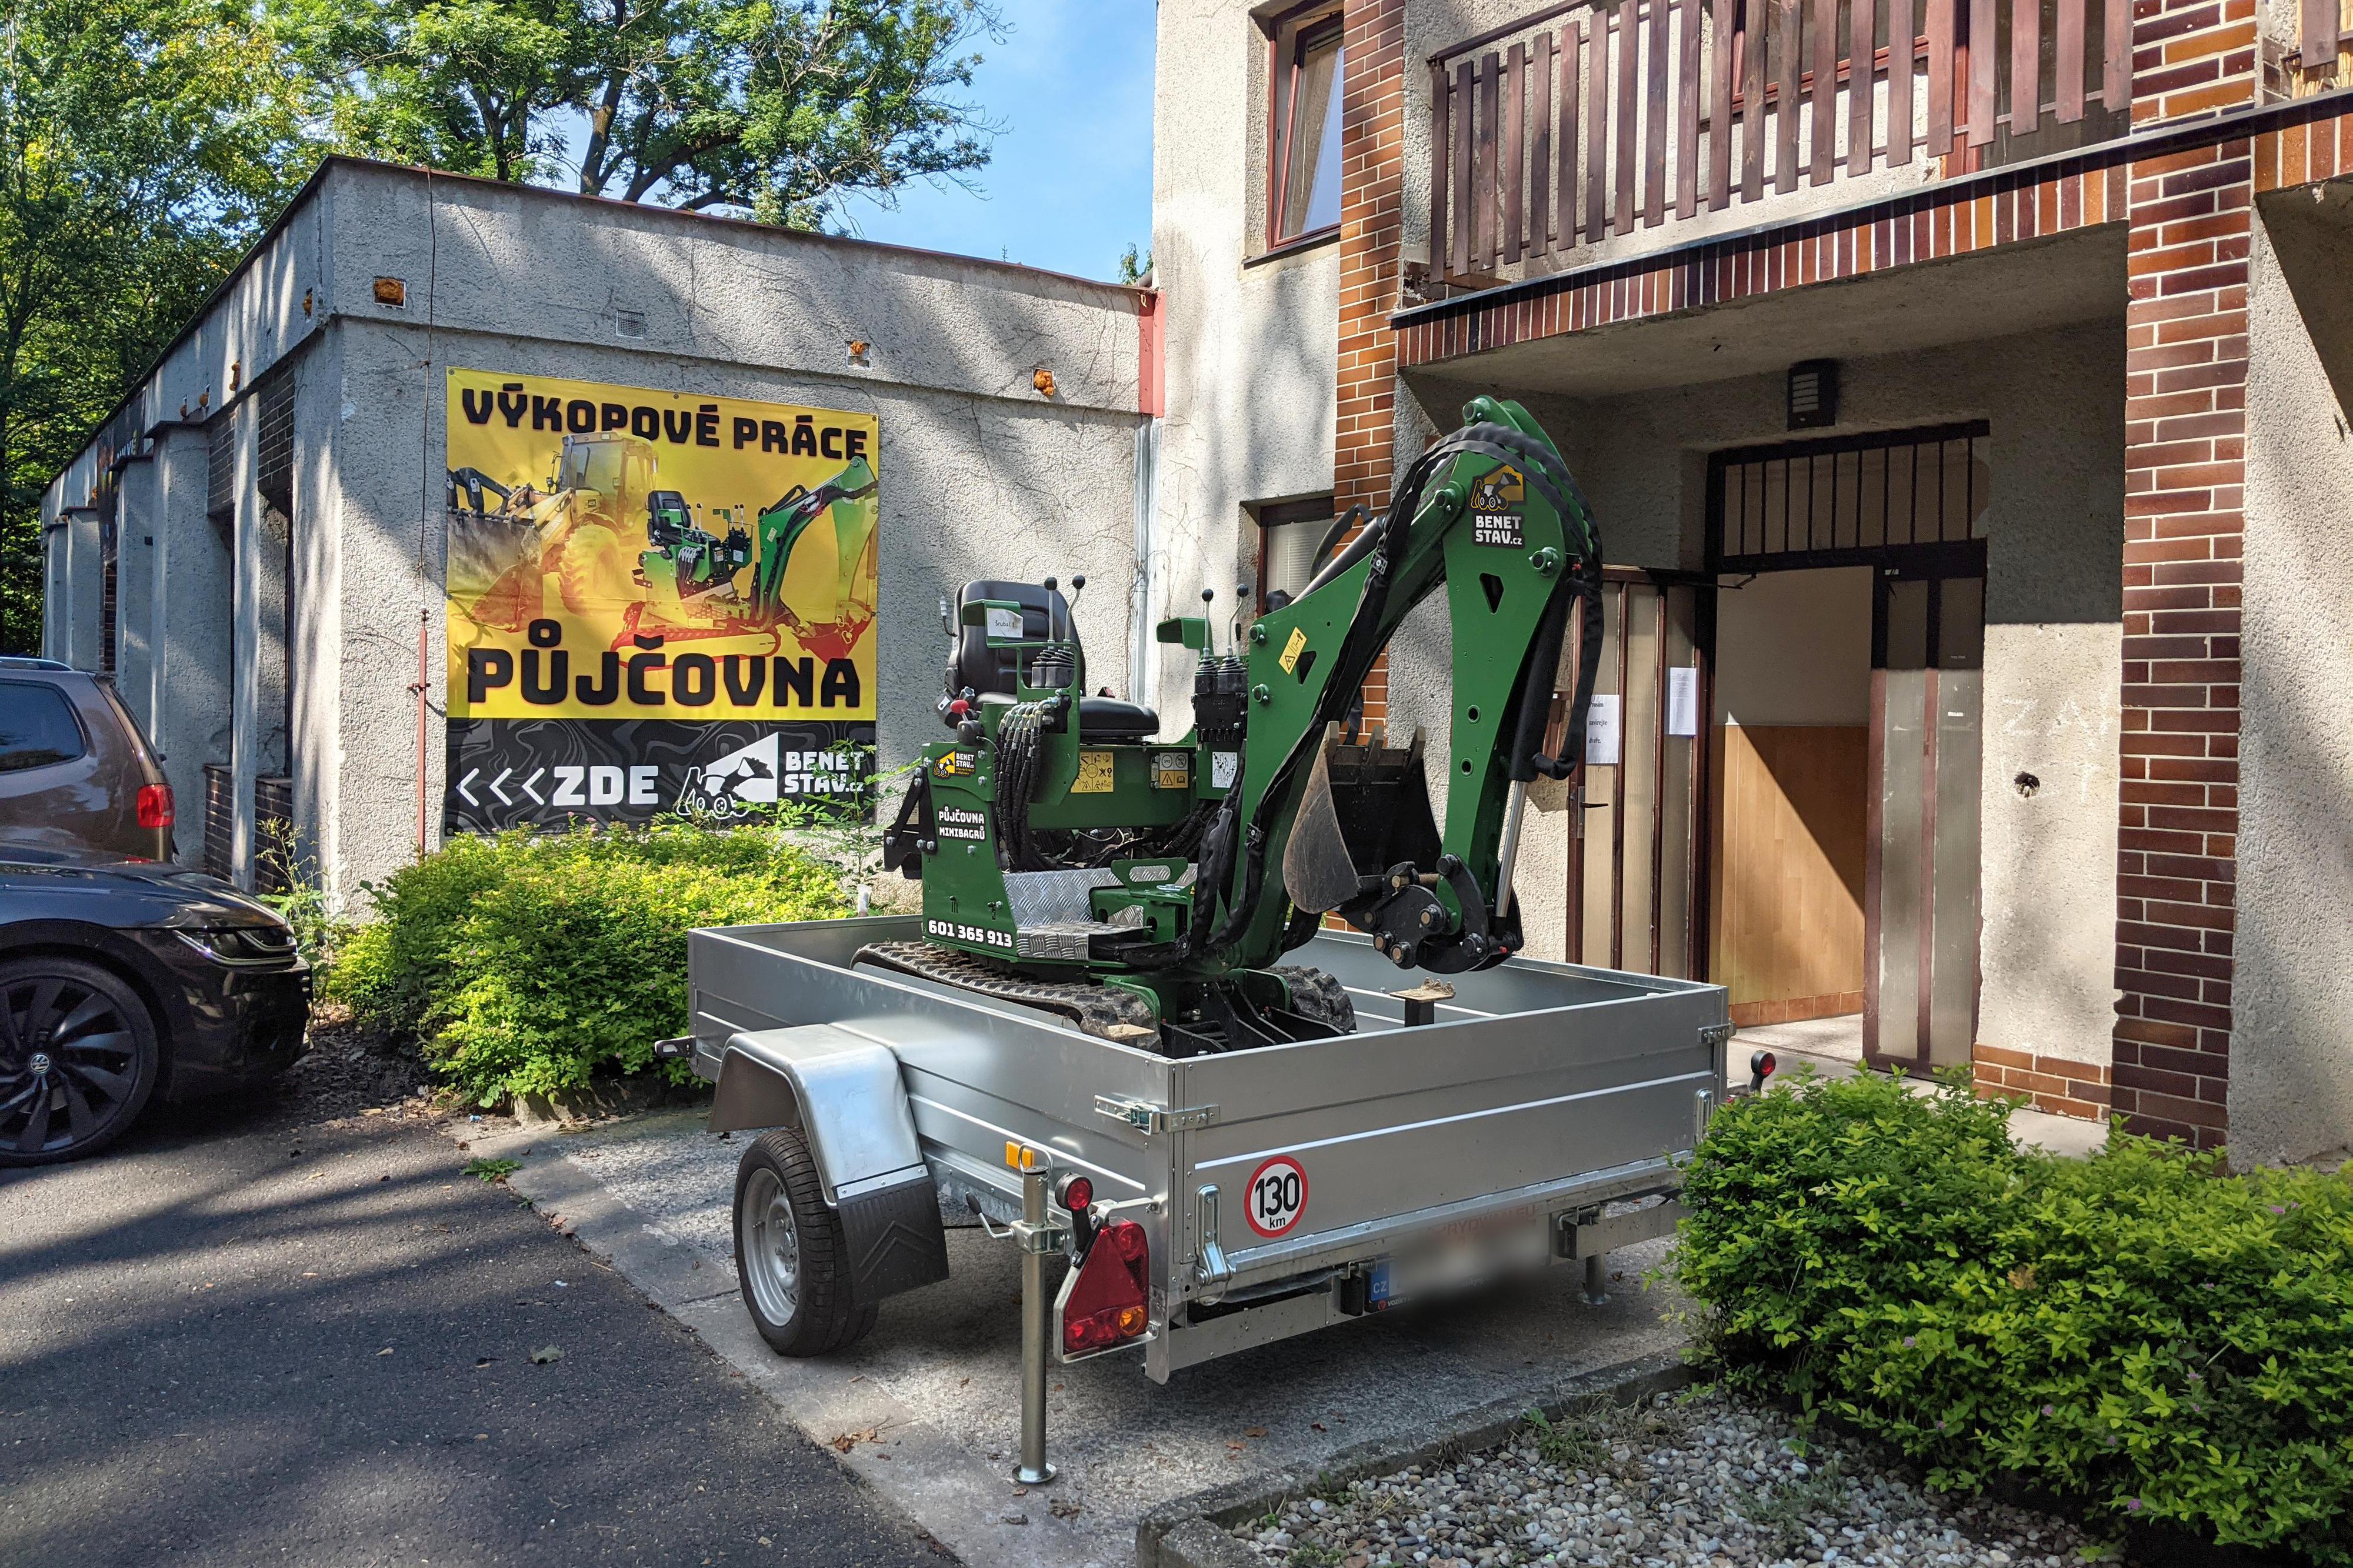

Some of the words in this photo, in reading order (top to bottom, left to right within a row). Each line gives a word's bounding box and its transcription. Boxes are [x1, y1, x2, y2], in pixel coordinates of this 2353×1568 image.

[462, 383, 719, 448] VÝKOPOVÉ
[734, 415, 868, 461] PRÁCE
[1475, 515, 1521, 529] BENET
[468, 618, 861, 708] PŮJČOVNA
[786, 752, 864, 771] BENET
[956, 753, 975, 761] BENET
[553, 766, 659, 806] ZDE
[938, 806, 985, 823] PŮJČOVNA
[939, 826, 985, 840] MINIBAGRŮ
[928, 920, 955, 937] 601
[958, 925, 984, 942] 365
[987, 930, 1012, 948] 913
[1255, 1172, 1299, 1219] 130
[1269, 1217, 1286, 1229] km
[1373, 1280, 1387, 1294] CZ
